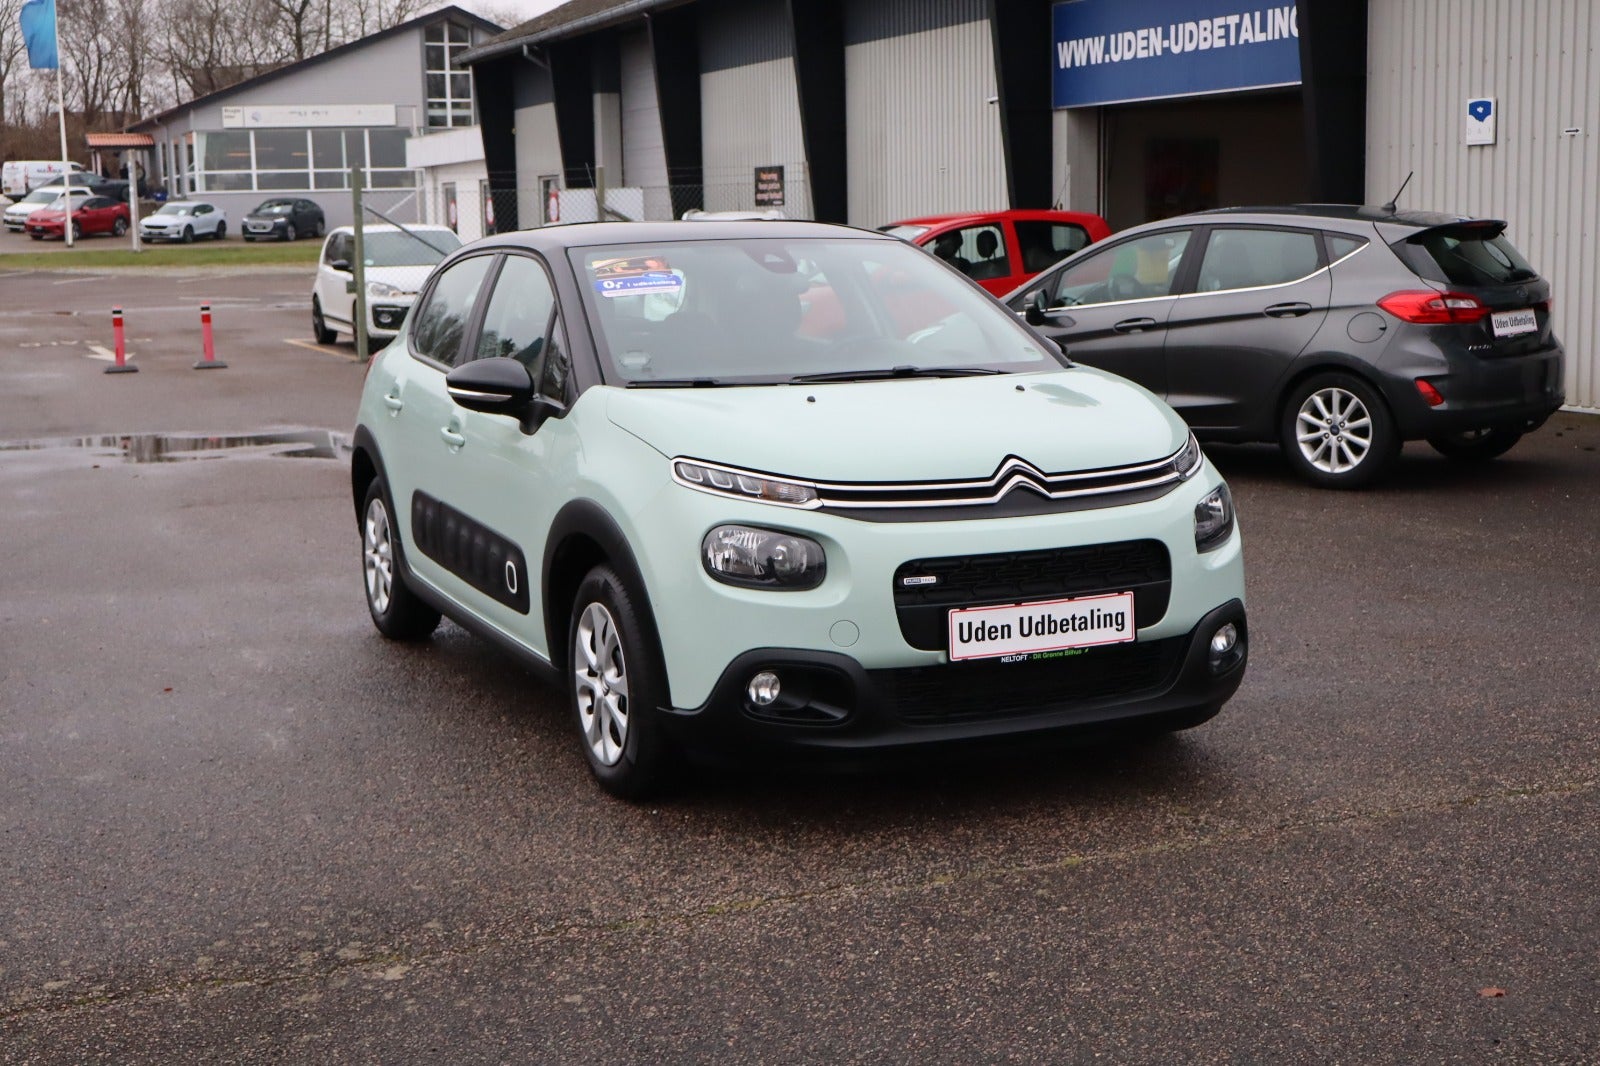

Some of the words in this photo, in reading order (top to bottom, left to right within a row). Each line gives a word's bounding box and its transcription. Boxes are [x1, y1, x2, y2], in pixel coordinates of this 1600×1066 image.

[1494, 318, 1509, 329] Uden
[1509, 314, 1535, 327] Udbetaling
[958, 619, 1013, 644] Uden
[1019, 608, 1126, 638] Udbetaling
[1001, 654, 1028, 663] NELTOFT
